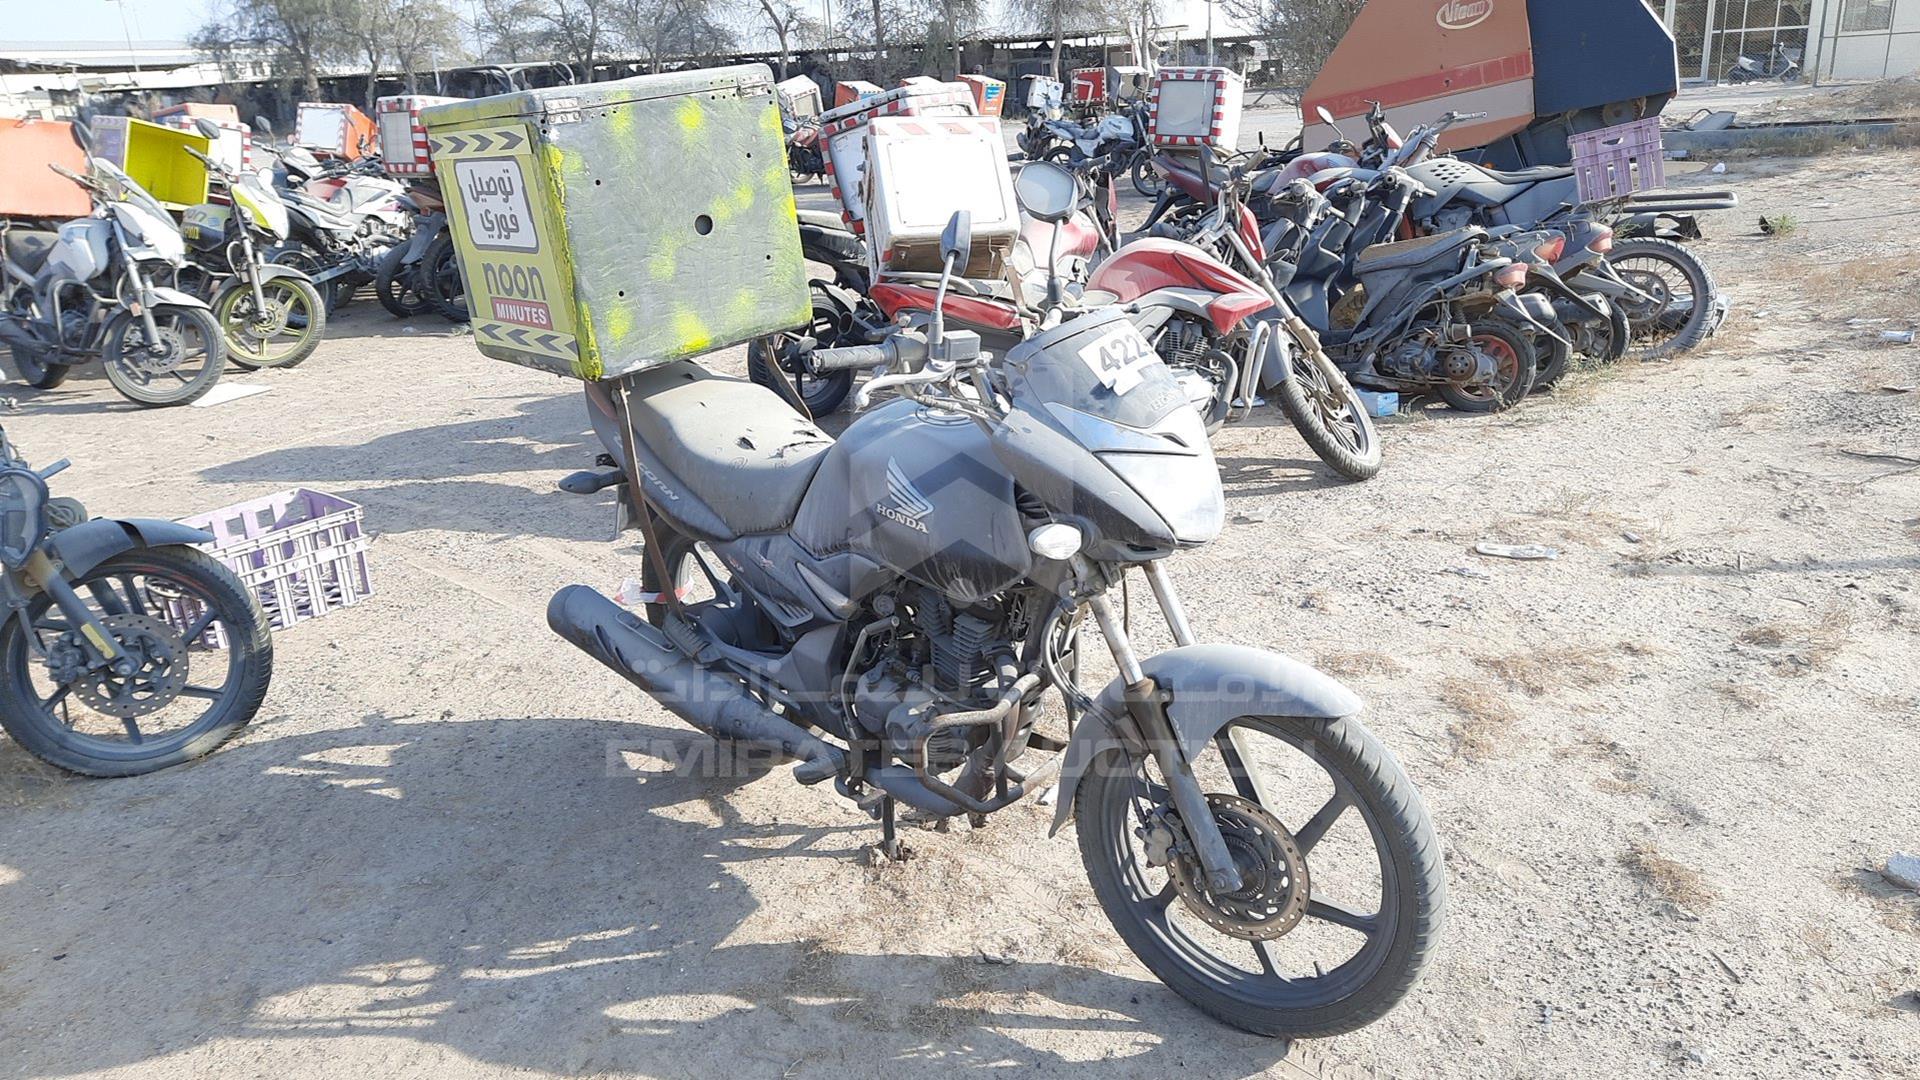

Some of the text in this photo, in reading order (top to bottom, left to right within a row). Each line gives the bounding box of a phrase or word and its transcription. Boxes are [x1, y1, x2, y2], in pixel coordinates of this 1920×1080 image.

[468, 168, 515, 203] توصيل
[480, 206, 520, 239] فوري
[481, 262, 546, 301] noon
[496, 303, 547, 325] MINUTES
[876, 503, 929, 535] HONDA
